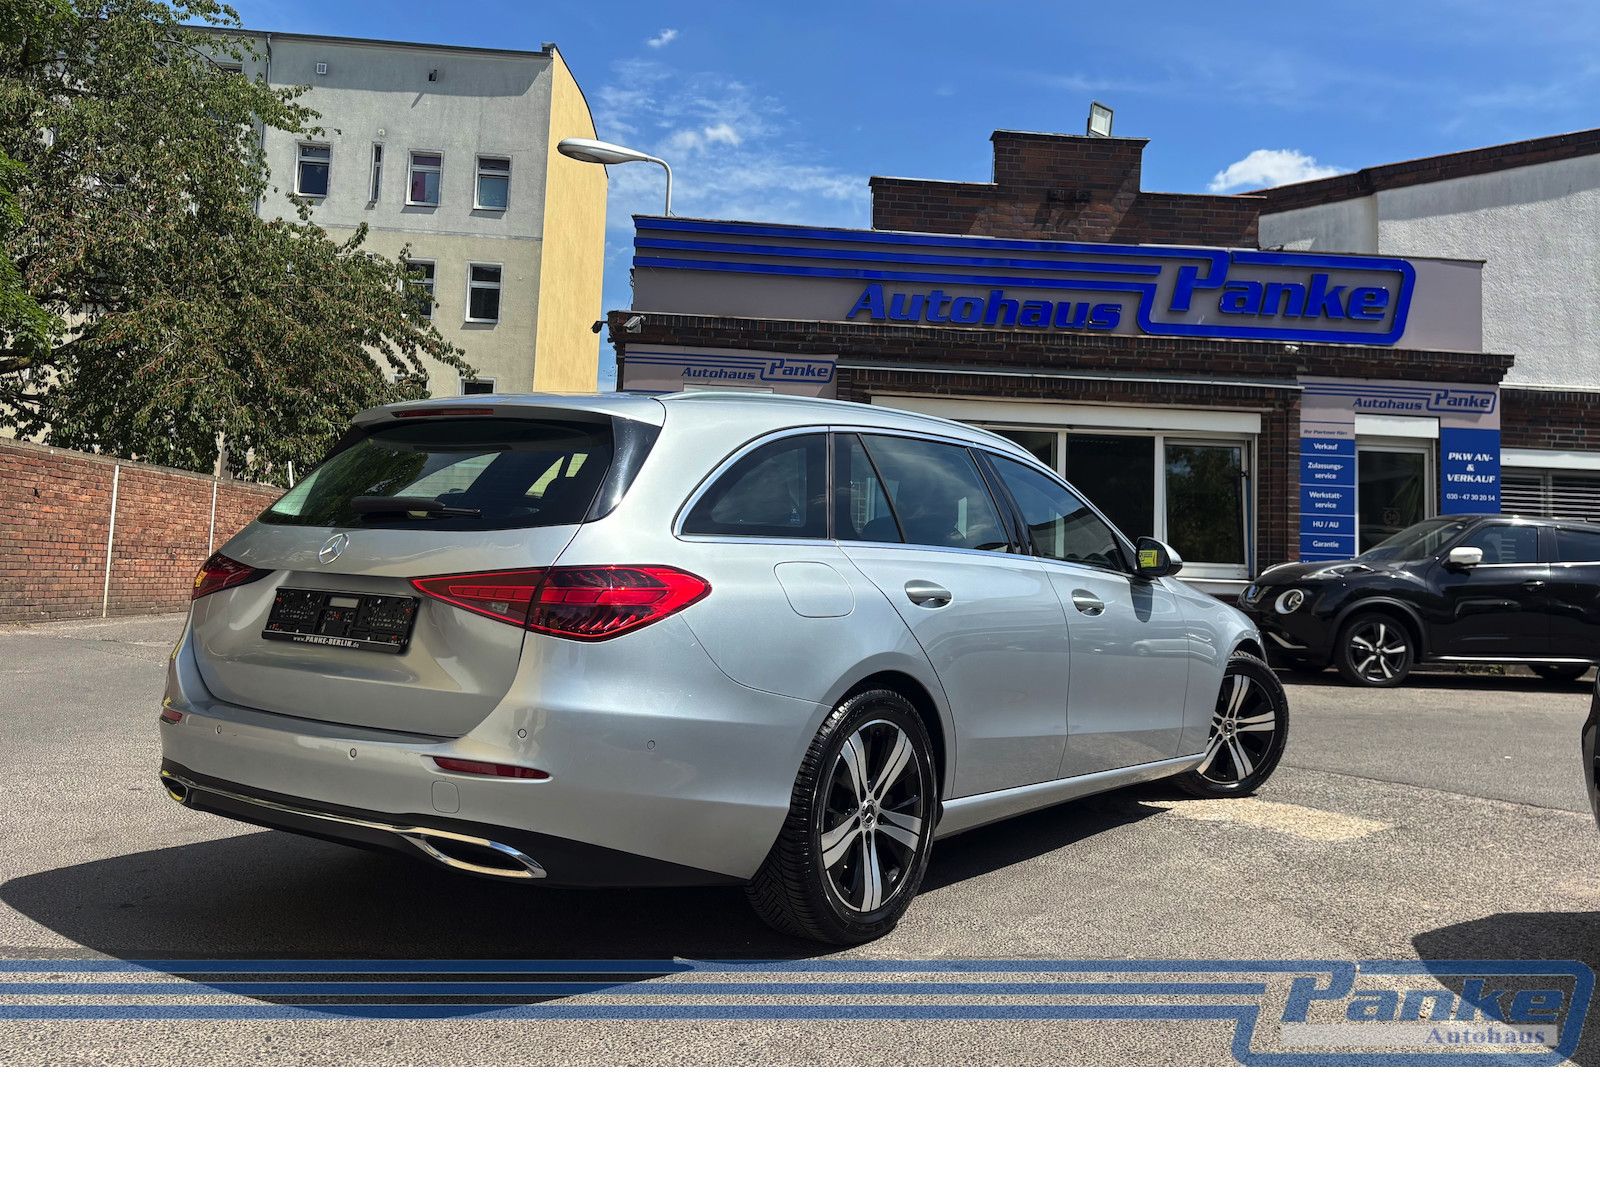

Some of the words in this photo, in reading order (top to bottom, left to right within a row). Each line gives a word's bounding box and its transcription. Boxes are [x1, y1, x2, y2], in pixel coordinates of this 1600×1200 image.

[846, 283, 1122, 332] Autohaus
[1168, 249, 1390, 322] Panke
[681, 366, 756, 380] Autohaus
[769, 358, 829, 377] Panke
[1352, 397, 1422, 411] Autohaus
[1434, 390, 1490, 408] Panke
[1313, 442, 1338, 451] Verkauf
[1448, 452, 1473, 461] PKW
[1473, 453, 1494, 462] AN-
[1307, 461, 1344, 471] Zulassungs-
[1466, 463, 1475, 472] &
[1314, 472, 1337, 480] service
[1447, 473, 1496, 484] VERKAUF
[1309, 491, 1343, 500] Werkstatt-
[1488, 494, 1496, 502] 54
[1328, 521, 1339, 529] AU
[1312, 540, 1339, 548] Garantie
